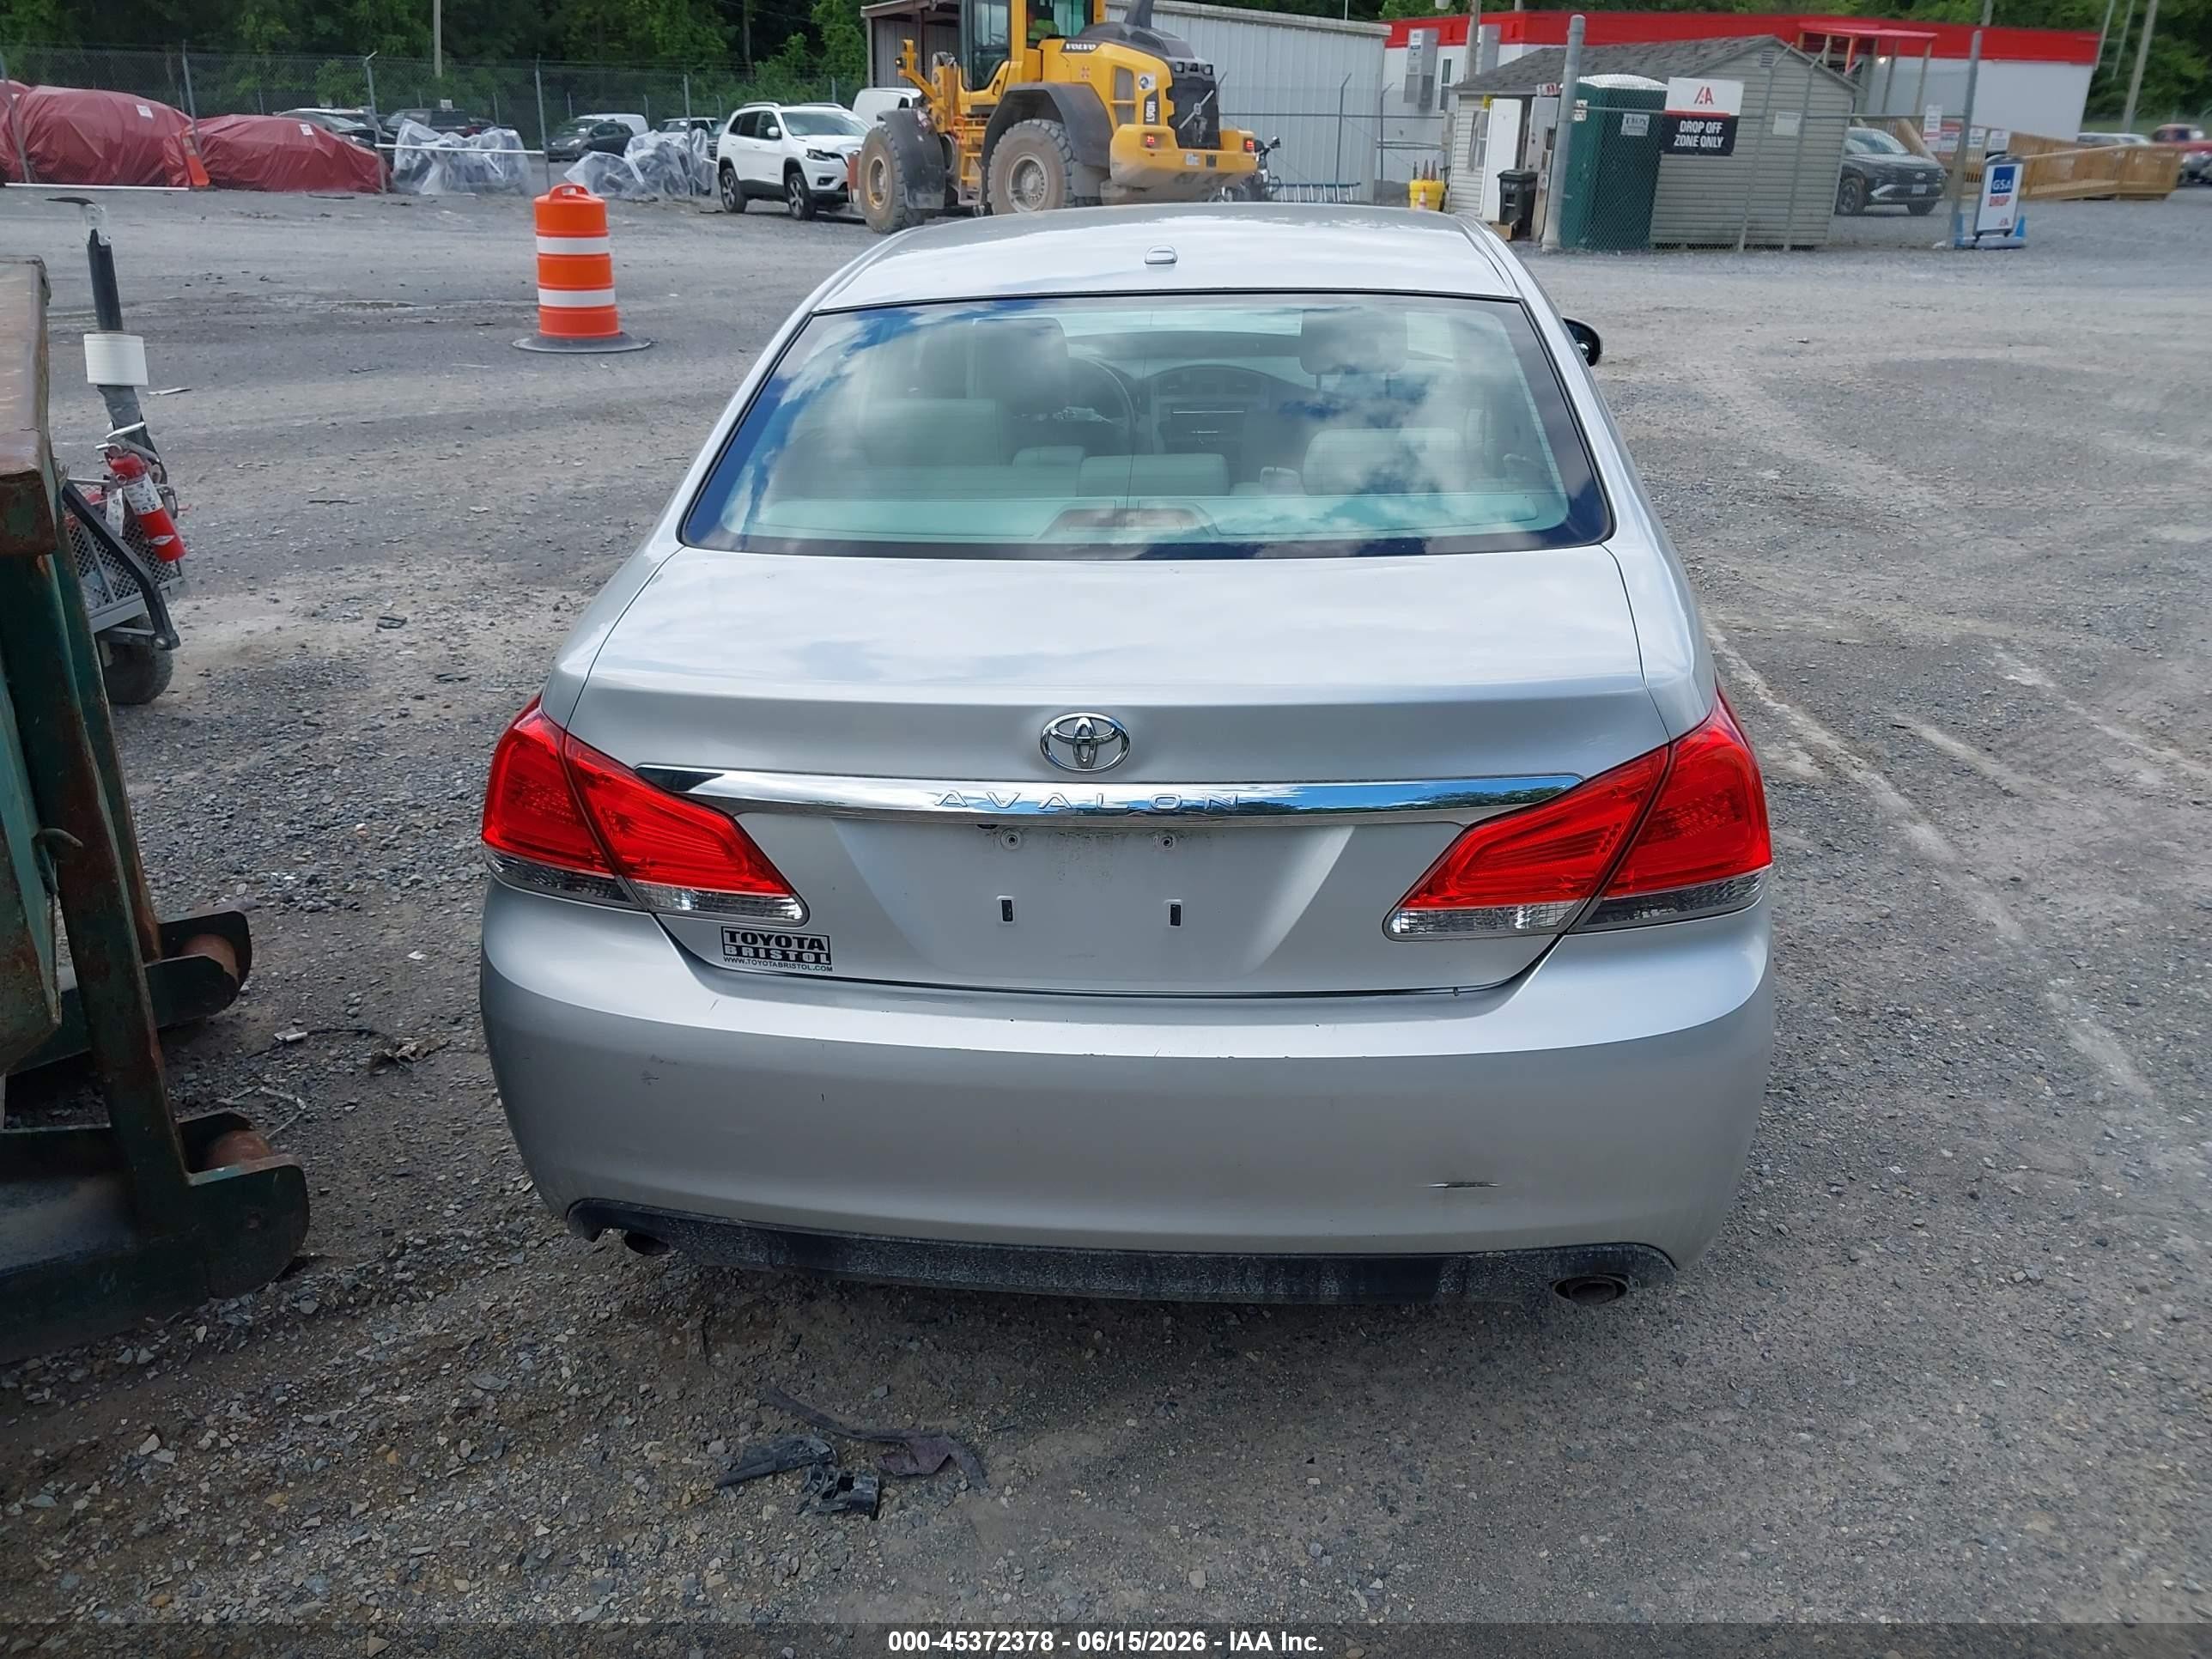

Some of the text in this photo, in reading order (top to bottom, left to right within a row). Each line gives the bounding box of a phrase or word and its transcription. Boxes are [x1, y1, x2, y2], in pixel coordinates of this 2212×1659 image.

[1680, 120, 1723, 134] DROP OFF
[1674, 135, 1724, 148] ZONE ONLY
[1992, 179, 2012, 191] GSA
[934, 789, 1240, 811] AVALON
[724, 930, 826, 951] TOYOTA
[724, 945, 831, 963] BRISTOL
[723, 956, 833, 972] WWW.TOYOTABRISTOL.COM
